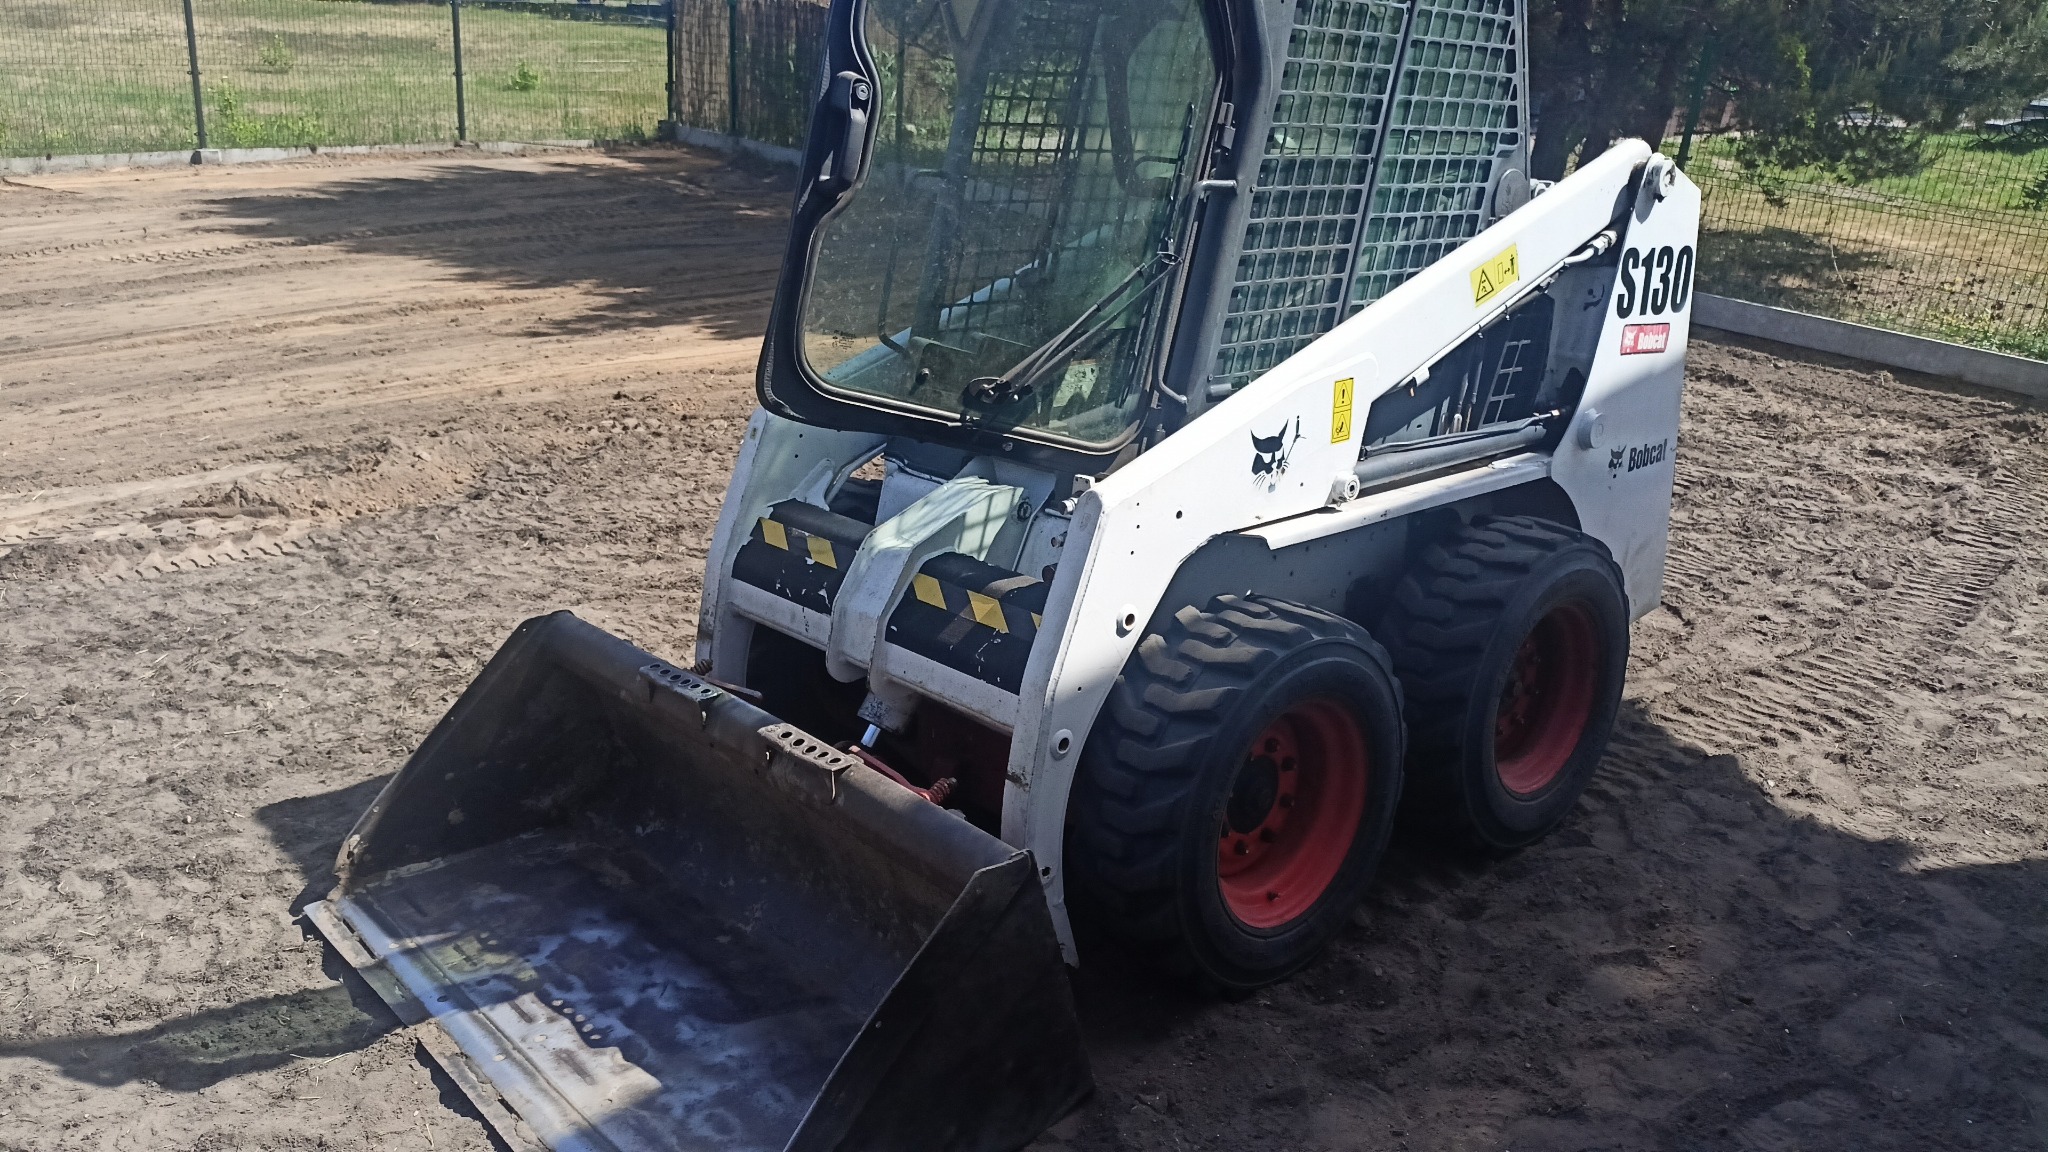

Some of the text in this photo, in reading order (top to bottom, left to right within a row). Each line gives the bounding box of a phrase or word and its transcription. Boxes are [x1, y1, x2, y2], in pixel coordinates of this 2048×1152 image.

[1617, 245, 1693, 319] S130
[1637, 331, 1667, 350] Bobcat
[1628, 439, 1668, 472] Bobcat
